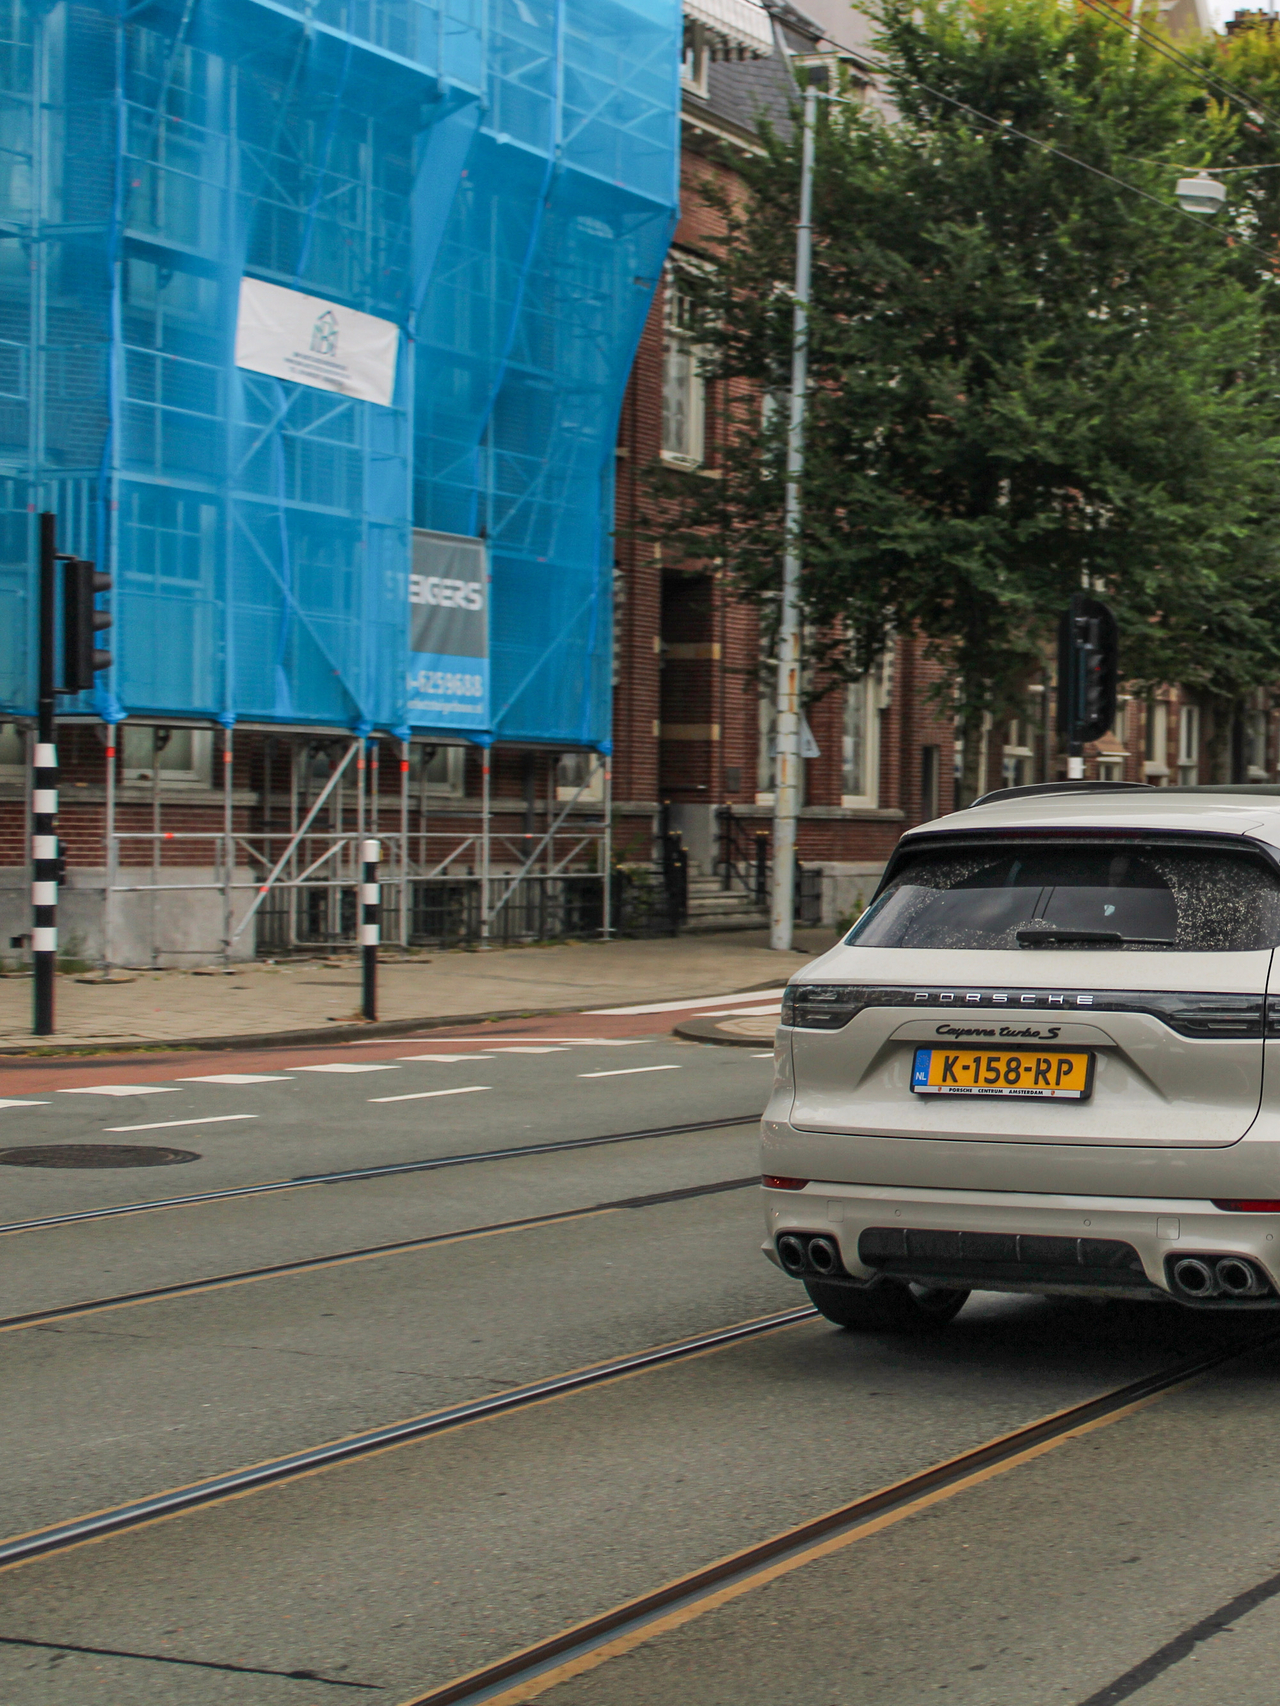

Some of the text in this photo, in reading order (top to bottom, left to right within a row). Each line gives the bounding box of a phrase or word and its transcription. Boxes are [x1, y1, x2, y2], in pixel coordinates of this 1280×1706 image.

[914, 993, 1094, 1005] PORSCHE
[935, 1024, 1062, 1040] Cayenne turbo S
[915, 1072, 927, 1081] NL
[941, 1055, 1074, 1086] K-158-RP
